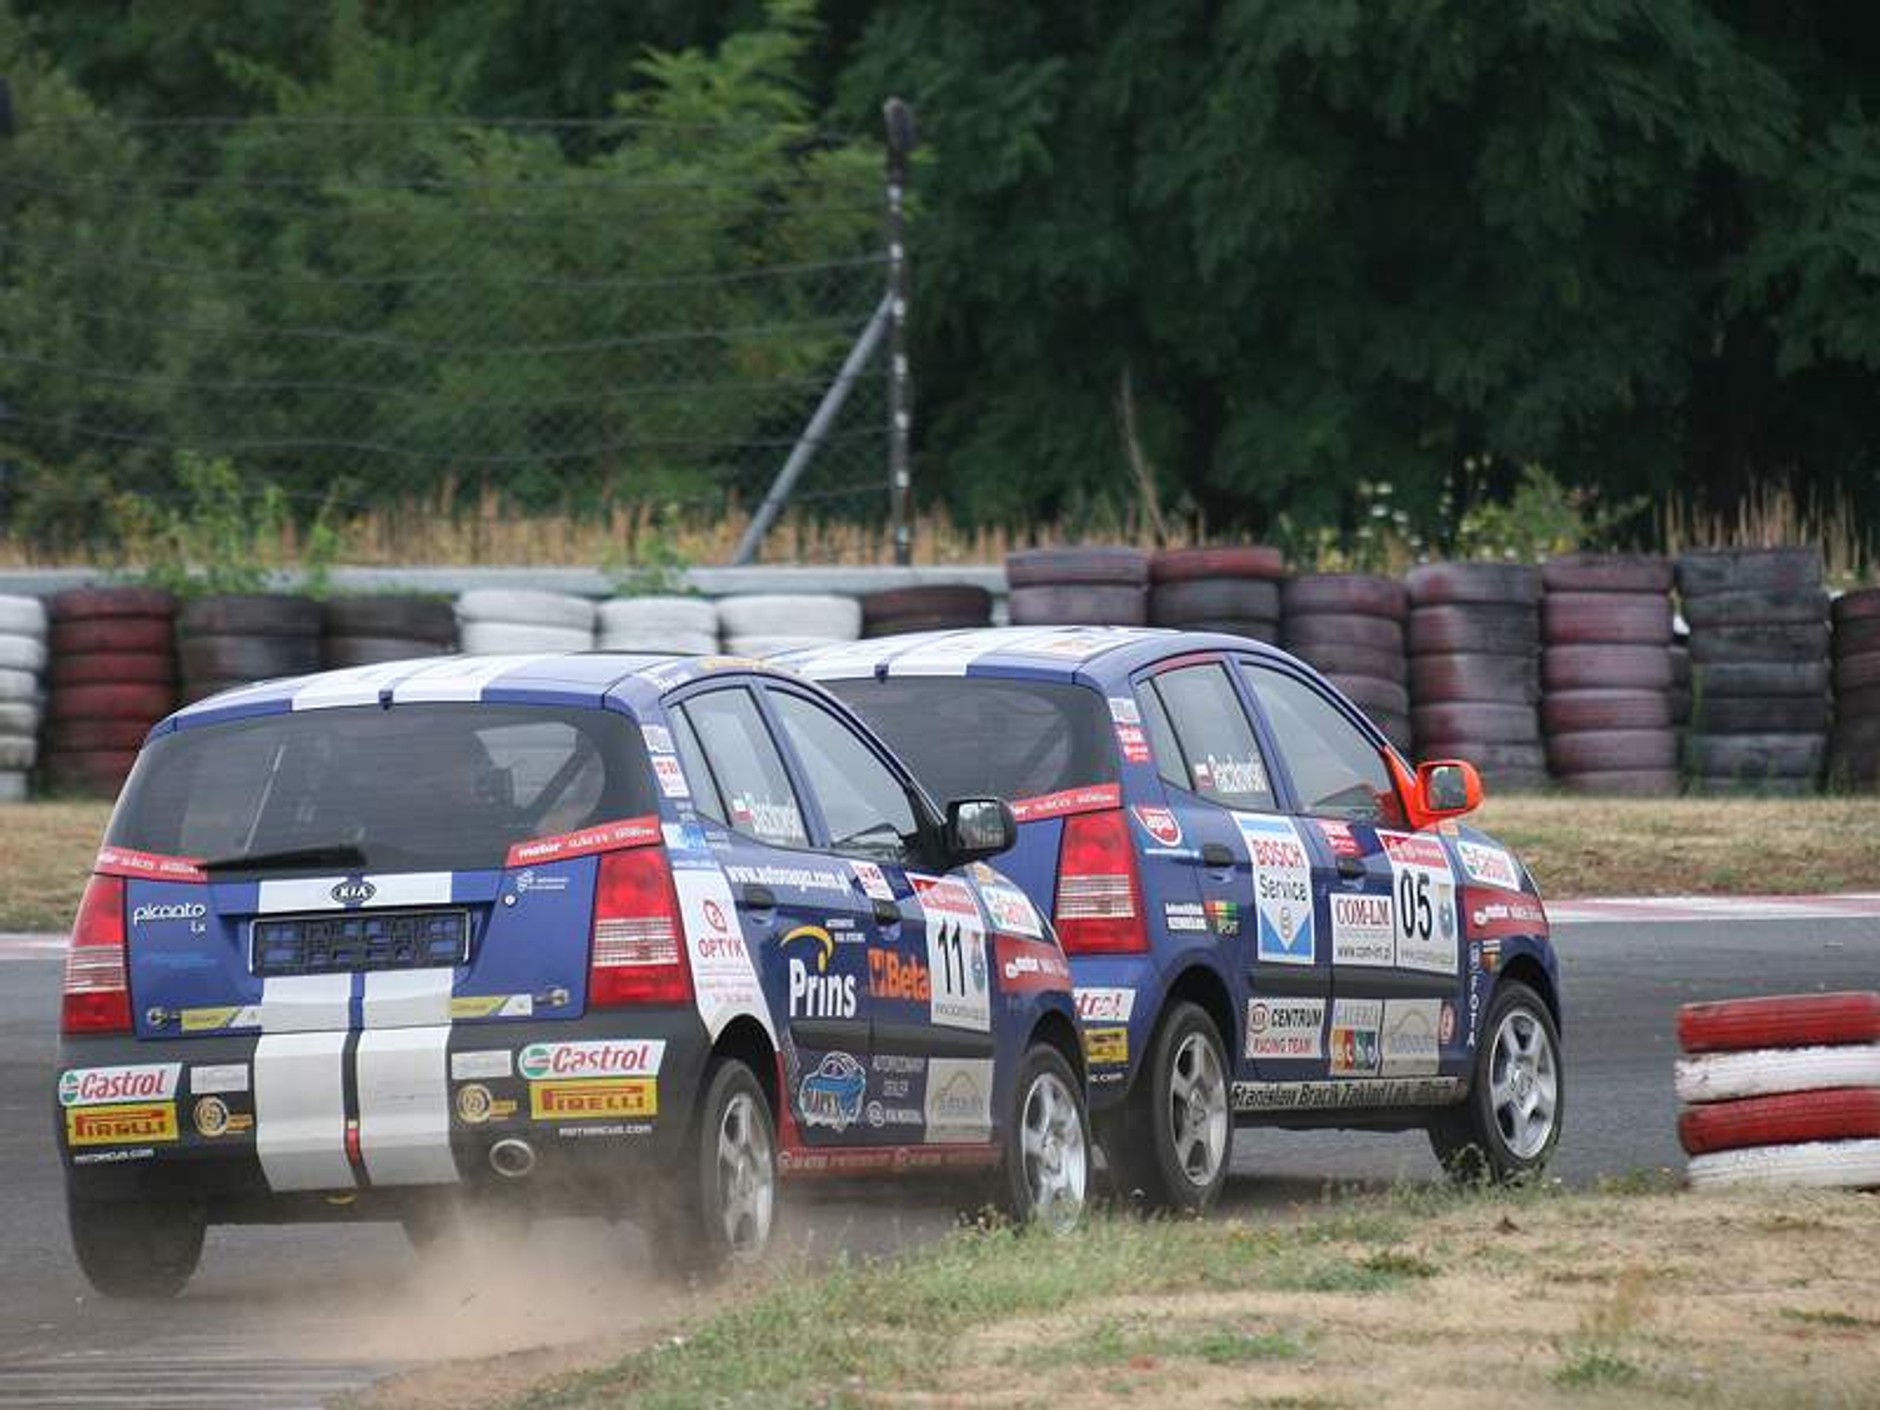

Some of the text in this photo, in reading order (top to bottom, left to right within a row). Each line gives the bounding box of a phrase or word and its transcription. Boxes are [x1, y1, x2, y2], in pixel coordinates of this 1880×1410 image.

[1252, 838, 1305, 868] BOSCH
[1259, 873, 1307, 902] Service
[133, 902, 206, 928] picanto
[1400, 868, 1433, 941] 05
[937, 916, 966, 998] 11
[789, 958, 857, 1019] Prins
[1270, 1006, 1323, 1029] CENTRUM
[551, 1045, 649, 1073] Castrol
[80, 1068, 167, 1099] Castrol
[540, 1085, 645, 1112] PIRELLI
[75, 1108, 168, 1138] PIRELLI
